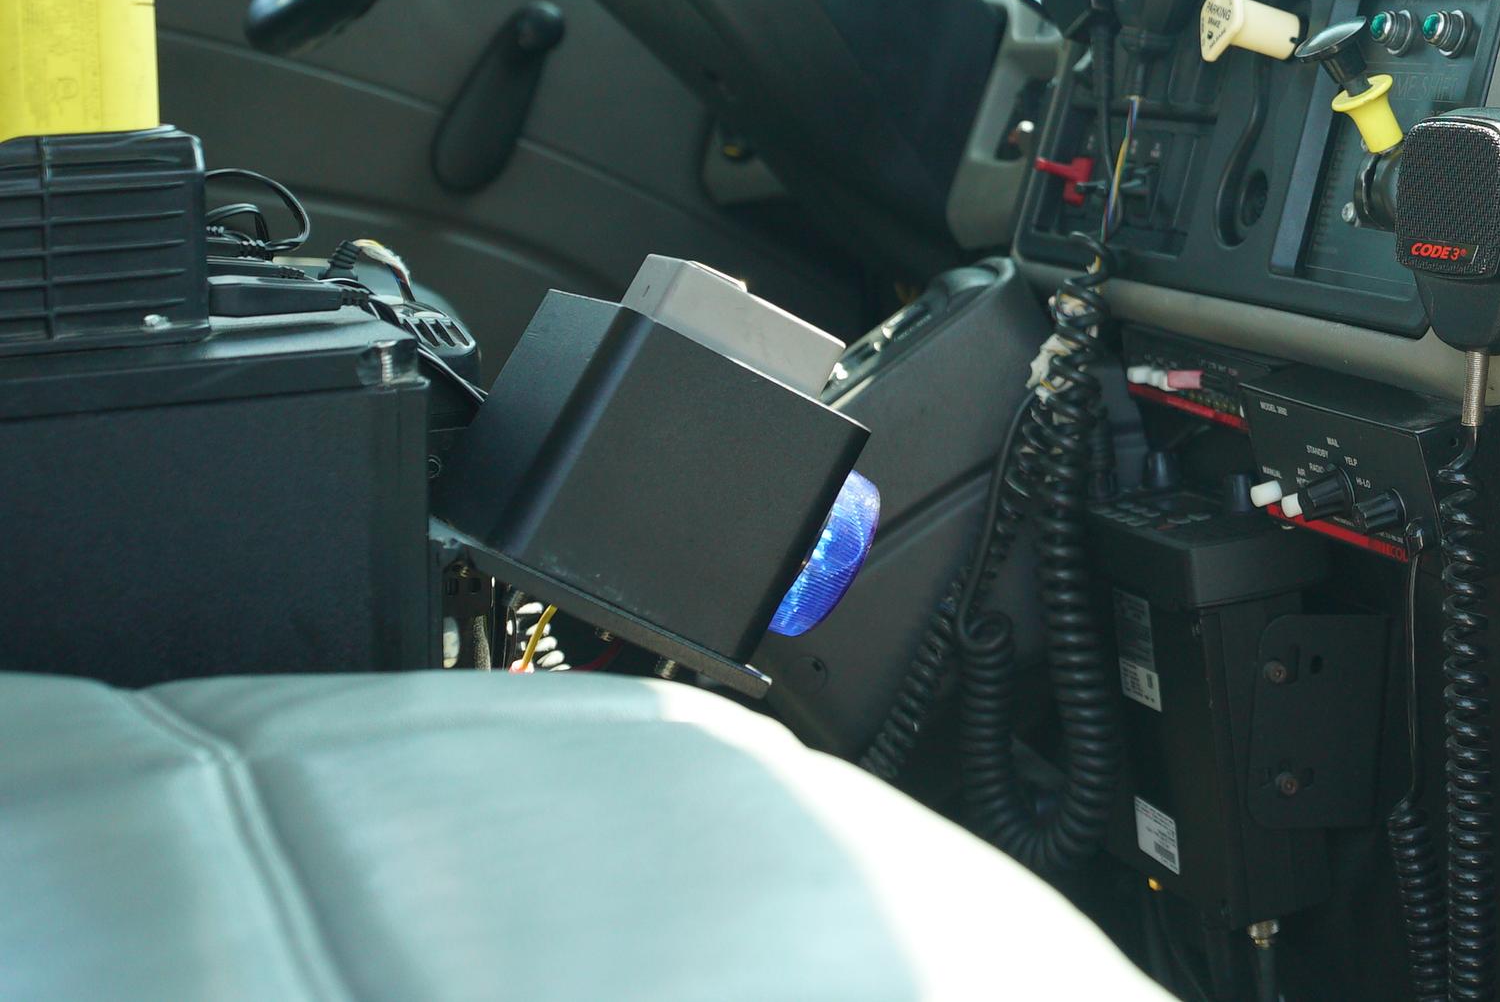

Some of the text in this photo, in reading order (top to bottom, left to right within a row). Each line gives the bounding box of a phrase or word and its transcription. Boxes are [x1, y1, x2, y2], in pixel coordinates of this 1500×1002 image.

[1410, 242, 1451, 260] CODE
[1306, 444, 1328, 458] STANDBY
[1344, 456, 1358, 467] YELP
[1356, 477, 1371, 489] HI-LO
